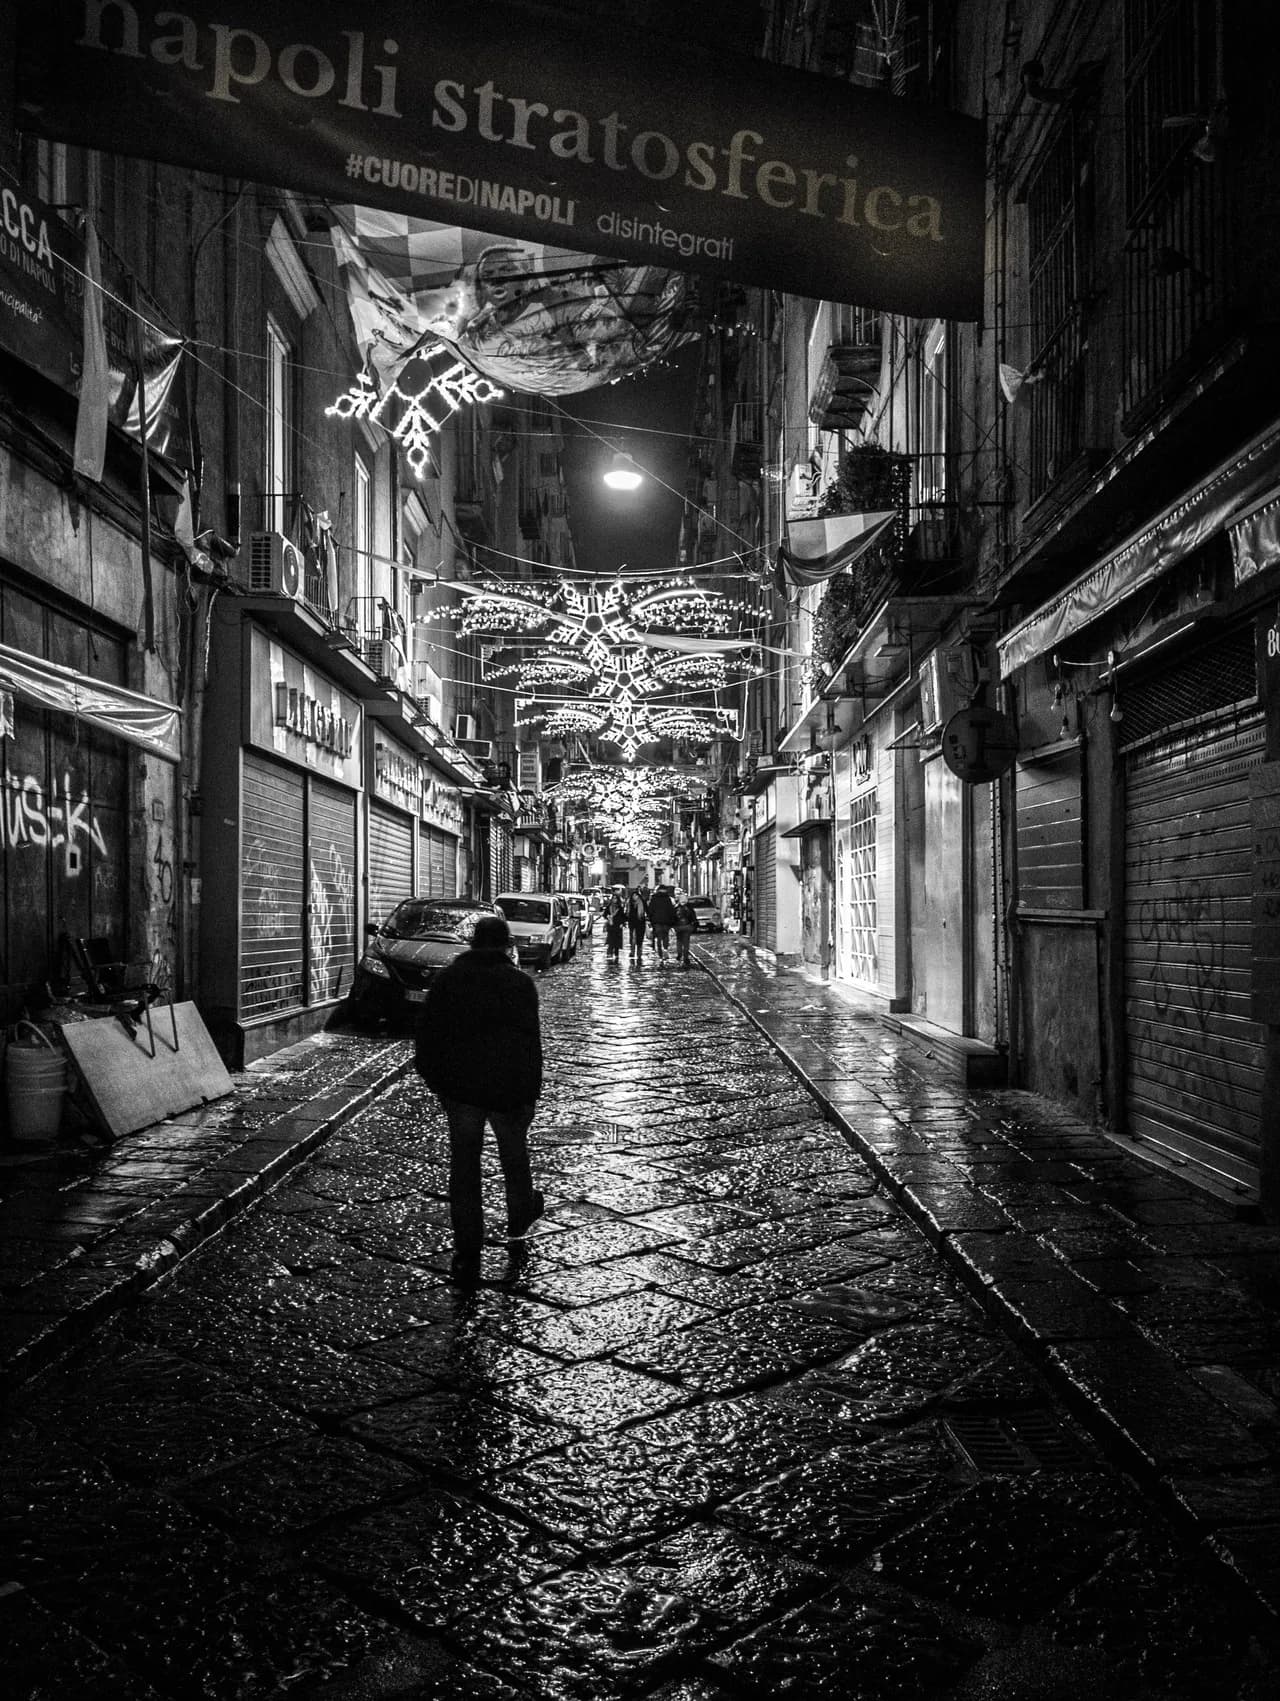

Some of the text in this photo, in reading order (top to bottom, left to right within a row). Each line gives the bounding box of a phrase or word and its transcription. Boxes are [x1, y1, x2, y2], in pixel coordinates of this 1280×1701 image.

[74, 0, 403, 119] napoli
[346, 153, 575, 225] #CUOREDINAPOLI
[432, 78, 944, 241] stratosferica
[0, 188, 54, 270] CCA
[597, 211, 734, 261] disintegrati
